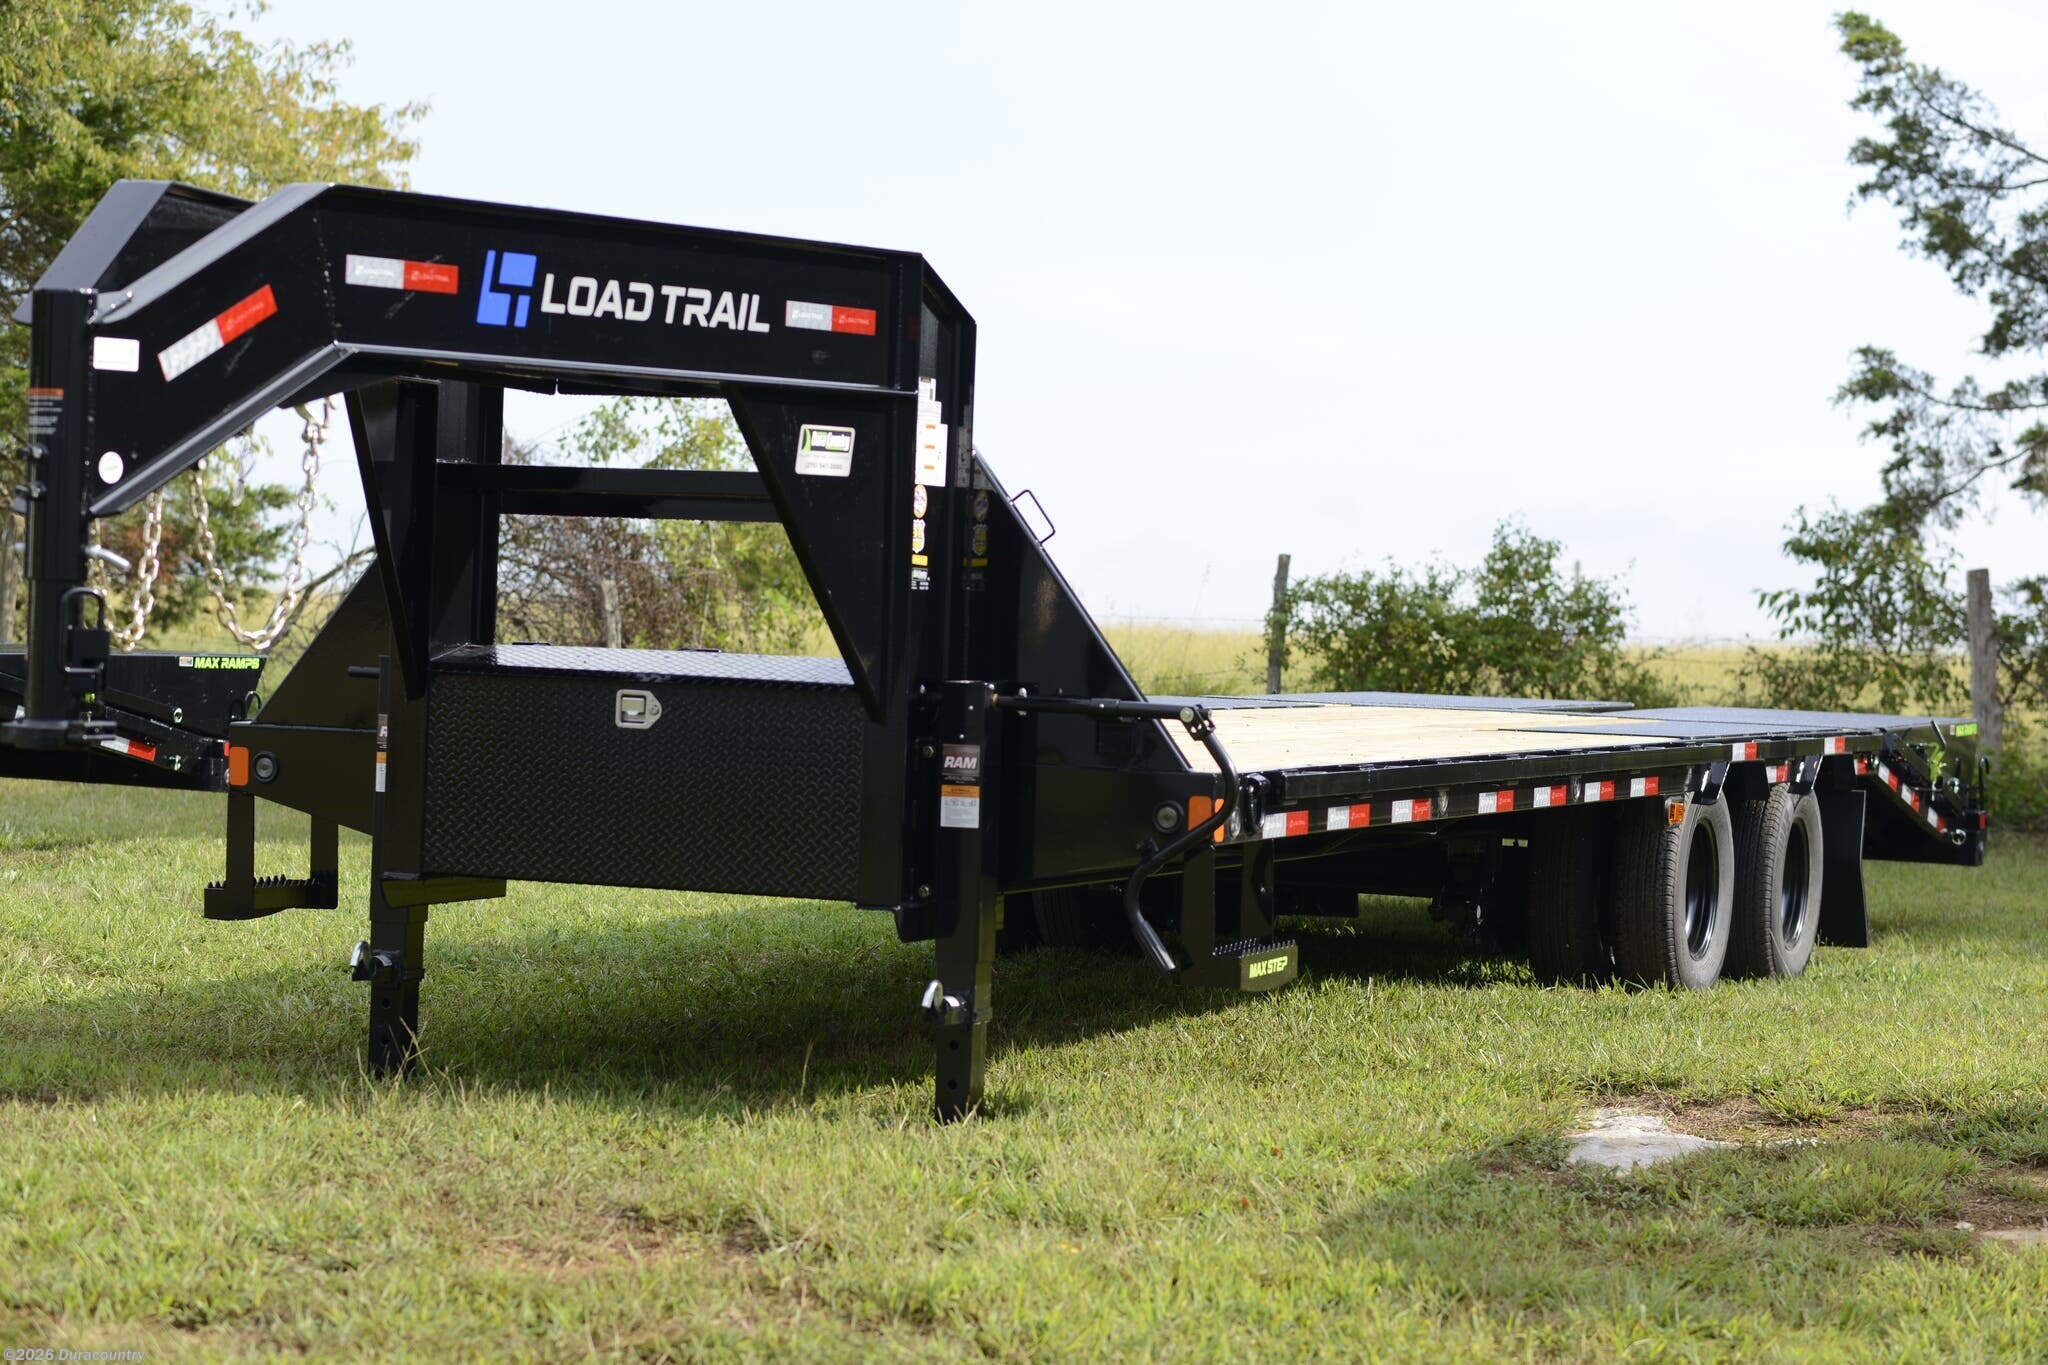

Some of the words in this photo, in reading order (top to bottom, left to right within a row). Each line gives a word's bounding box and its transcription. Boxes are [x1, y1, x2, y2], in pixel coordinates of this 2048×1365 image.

[541, 273, 655, 322] LOAD
[661, 284, 770, 333] TRAIL
[194, 657, 220, 669] MAX
[220, 657, 260, 669] RAMPS
[944, 755, 978, 770] RAM
[1249, 961, 1267, 978] MAX
[1267, 956, 1288, 974] STEP
